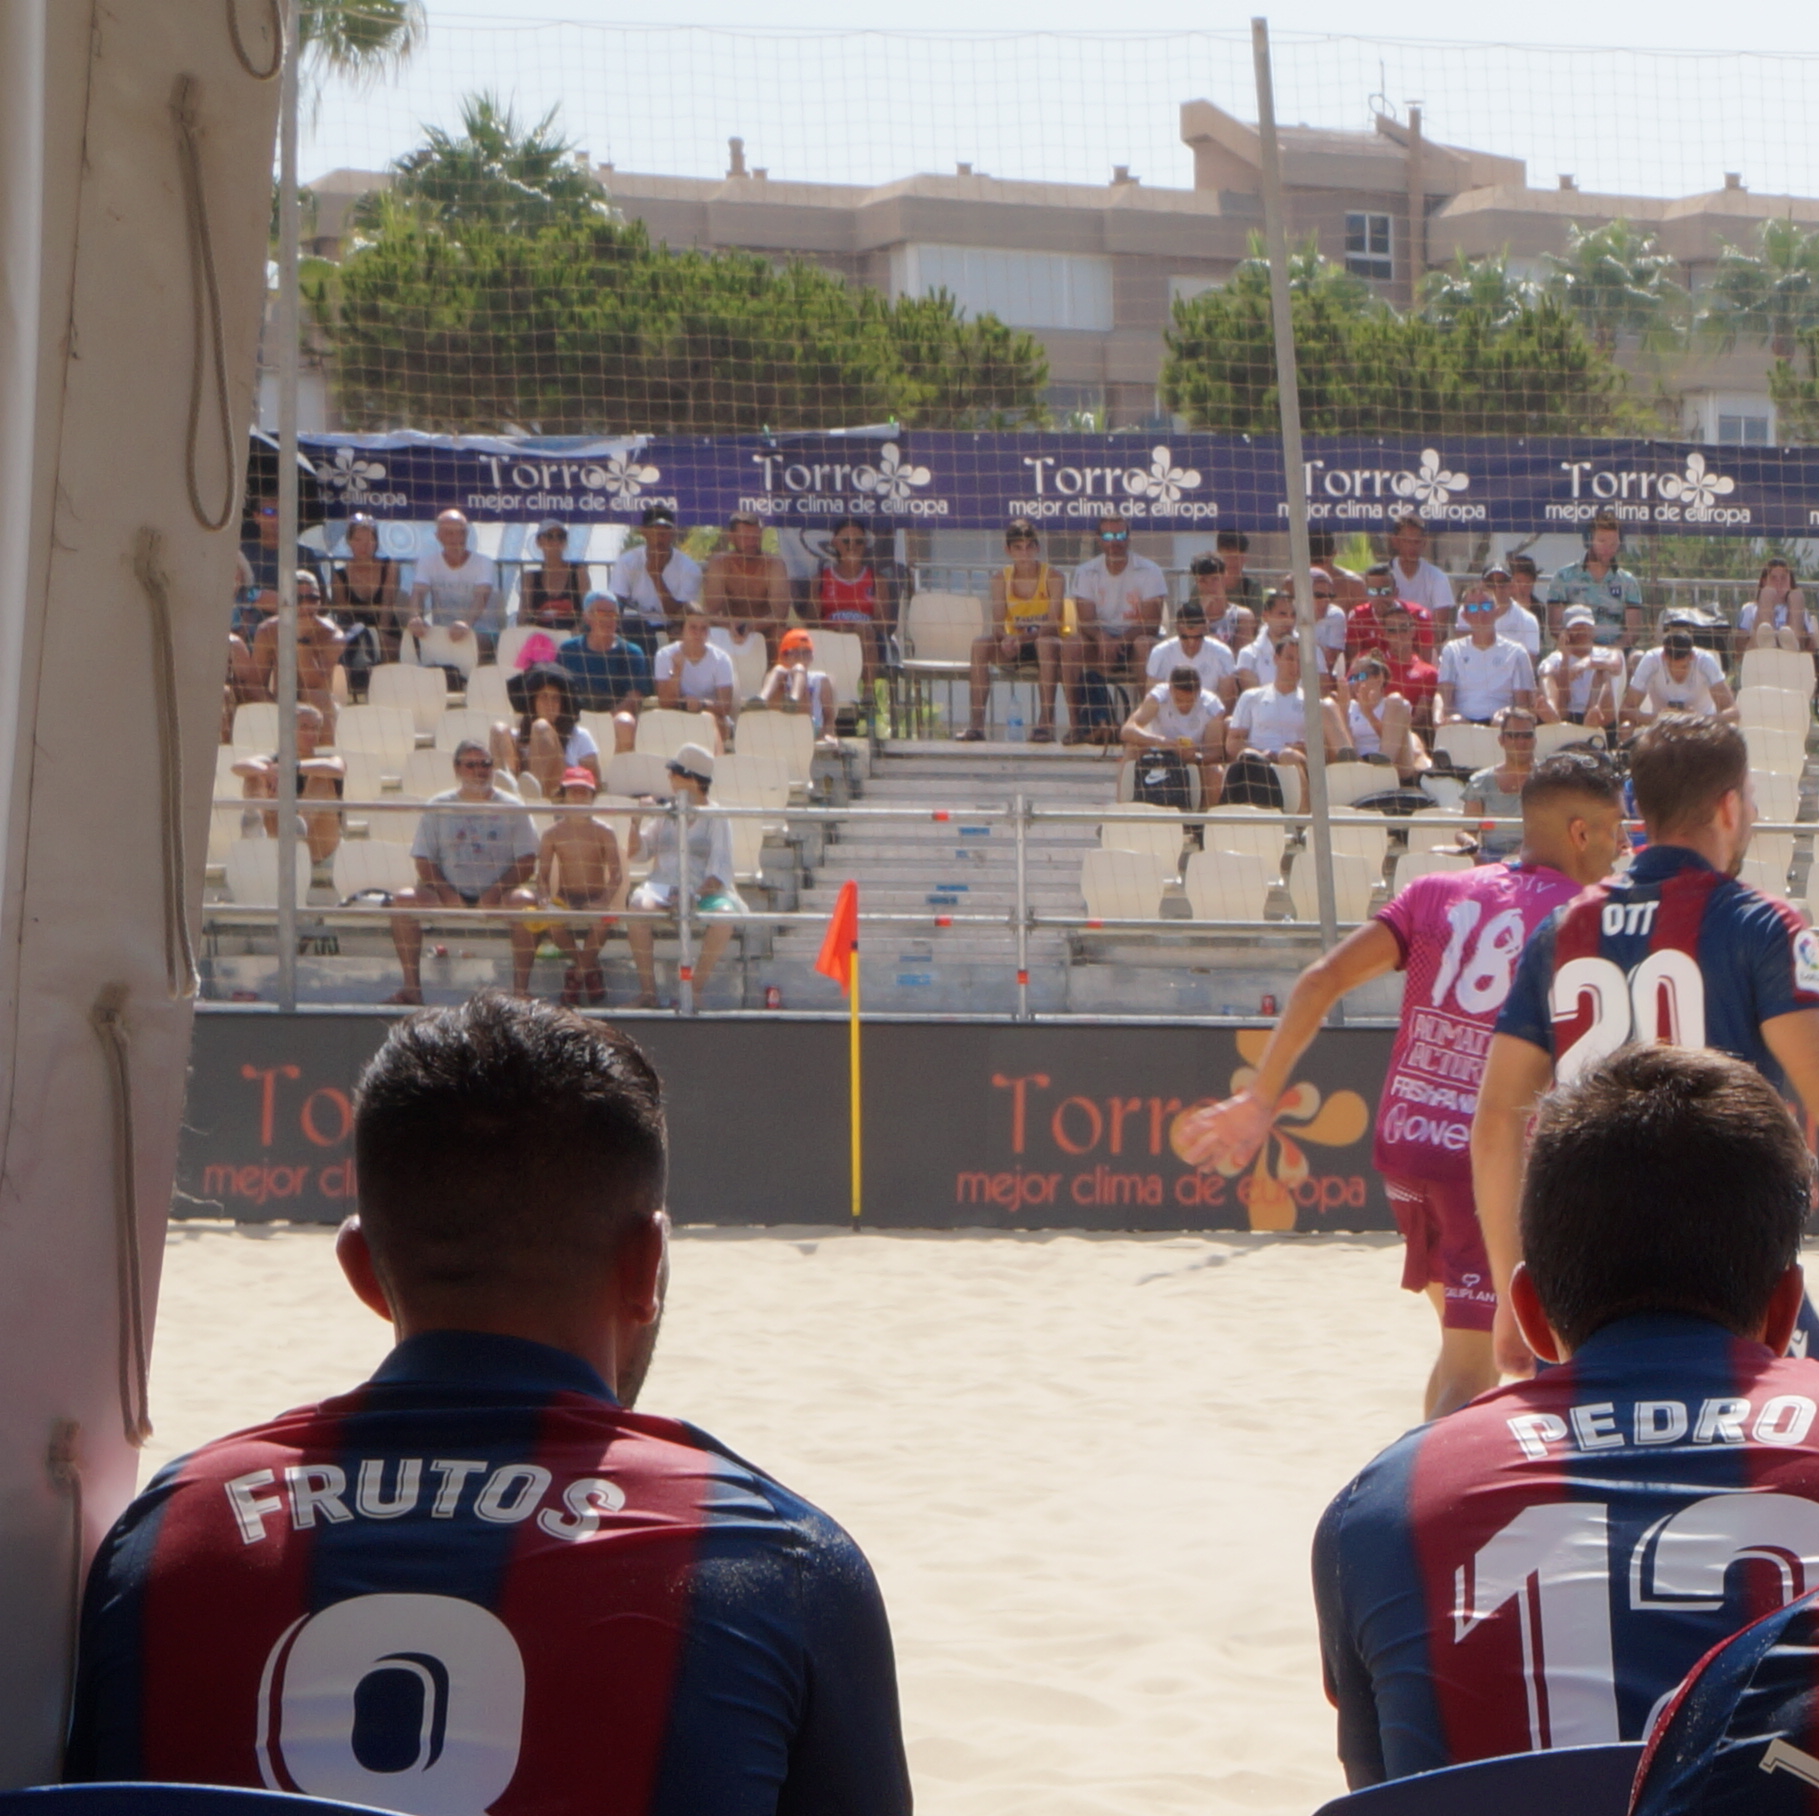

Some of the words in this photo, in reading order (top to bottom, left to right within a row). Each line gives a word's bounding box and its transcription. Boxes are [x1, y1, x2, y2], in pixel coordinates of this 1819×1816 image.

[340, 490, 407, 510] europa
[468, 491, 522, 512] mejor
[526, 490, 573, 510] clima
[579, 490, 607, 511] de
[609, 495, 678, 515] europa
[739, 494, 791, 516] mejor
[797, 494, 843, 513] clima
[849, 494, 876, 514] de
[881, 498, 948, 518] europa
[1009, 497, 1062, 519] mejor
[1067, 497, 1114, 517] clima
[1119, 497, 1145, 517] de
[1151, 501, 1218, 521] europa
[1278, 501, 1331, 522] mjor
[1335, 500, 1382, 518] clima
[1388, 501, 1413, 518] de
[1419, 503, 1486, 523] europa
[1545, 501, 1598, 522] mejor
[1655, 502, 1680, 522] de
[1685, 505, 1751, 527] europa
[1602, 900, 1660, 936] OTT
[1431, 899, 1526, 1015] 18
[1548, 948, 1705, 1088] 20
[204, 1157, 309, 1205] mejor
[956, 1166, 1062, 1212] mejor
[1071, 1166, 1162, 1206] clima
[1175, 1166, 1227, 1206] de
[1506, 1395, 1817, 1461] PEDRO
[224, 1458, 626, 1545] FRUTOS
